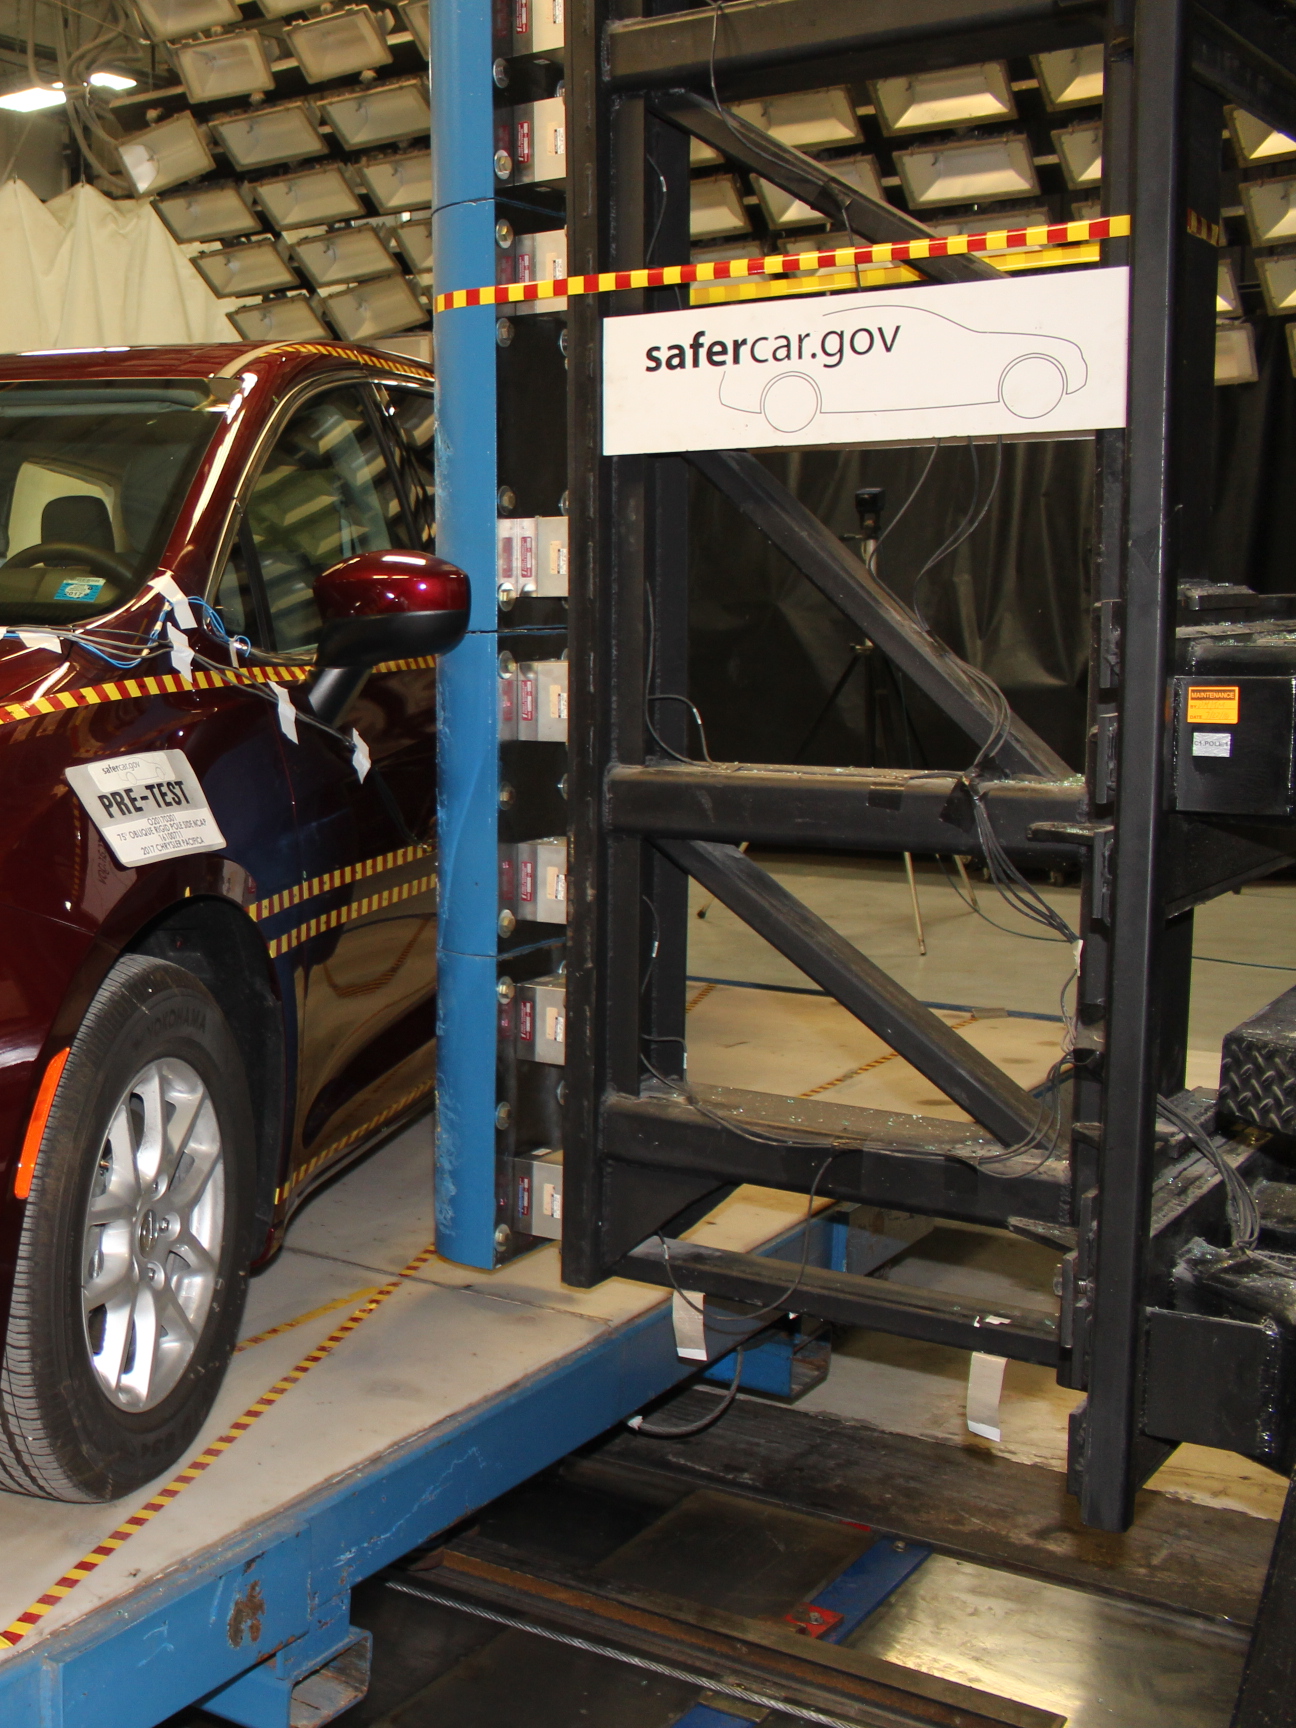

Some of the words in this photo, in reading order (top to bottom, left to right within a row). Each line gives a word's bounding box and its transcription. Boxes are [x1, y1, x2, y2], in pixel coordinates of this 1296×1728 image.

[645, 325, 901, 372] safercar.gov
[1191, 691, 1235, 699] MAINTENANCE
[102, 761, 141, 775] safercar.gov
[97, 780, 191, 819] PRE-TEST
[128, 827, 155, 839] OBLIQUE
[153, 823, 171, 834] RIGID
[169, 821, 184, 831] POLE
[192, 818, 207, 828] NCAP
[140, 844, 156, 856] 2017
[155, 839, 183, 852] CHRYSLER
[181, 836, 205, 847] PACIFICA
